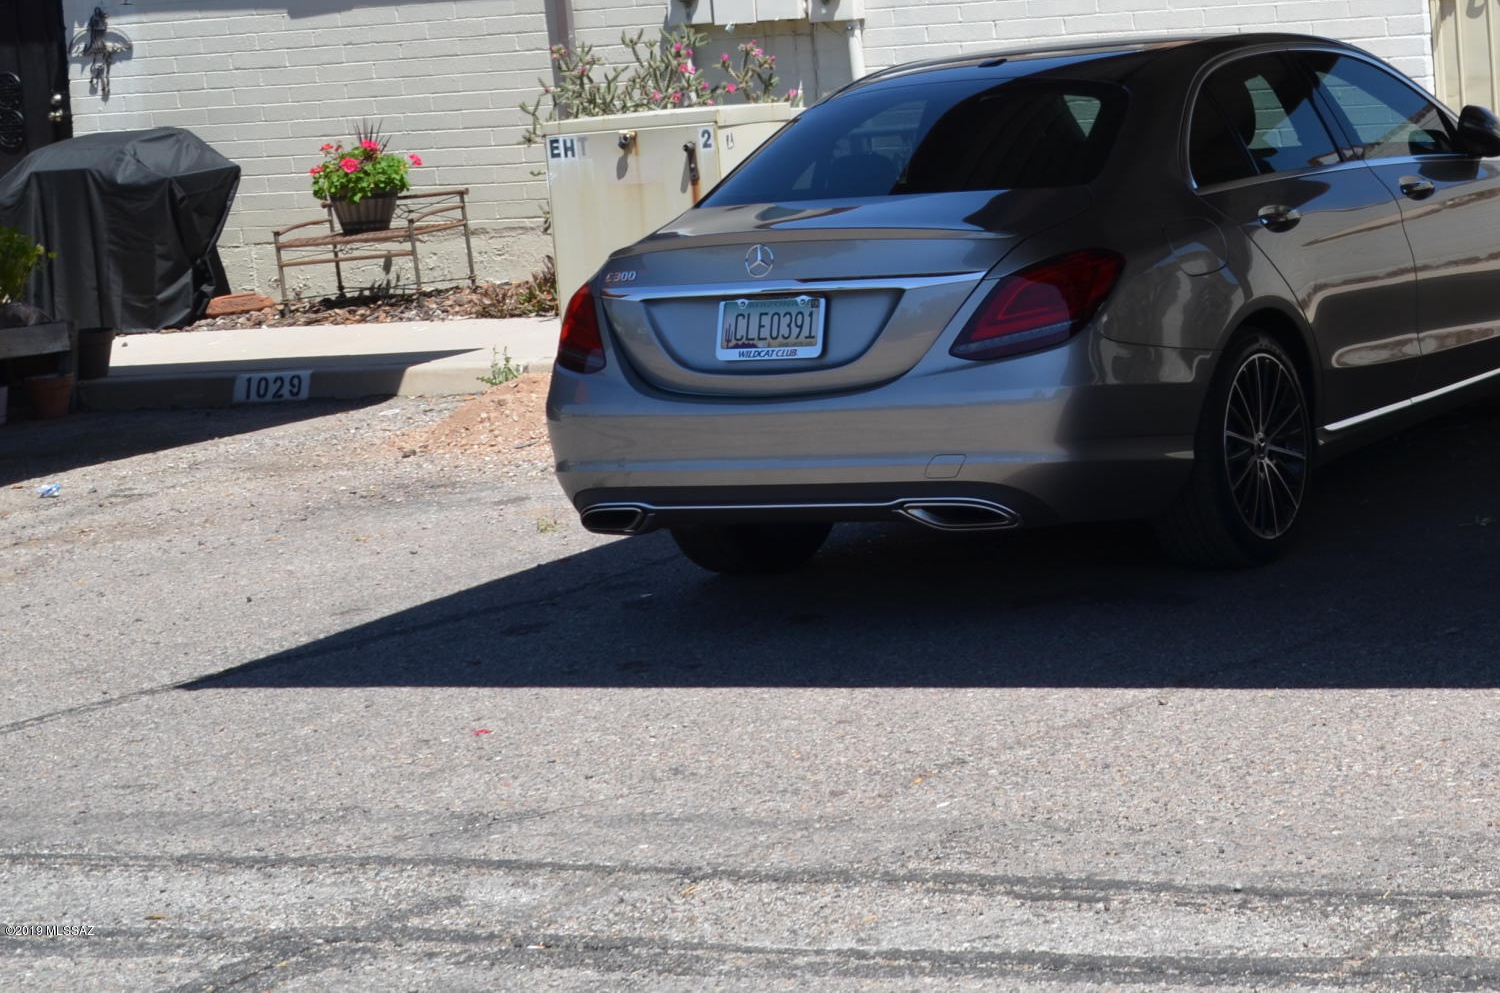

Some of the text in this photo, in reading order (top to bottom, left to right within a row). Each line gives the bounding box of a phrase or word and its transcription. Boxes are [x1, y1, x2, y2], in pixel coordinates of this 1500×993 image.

[701, 129, 712, 149] 2
[734, 309, 816, 342] CLE0391
[738, 348, 798, 359] WILDCAT CLUB
[245, 374, 302, 400] 1029
